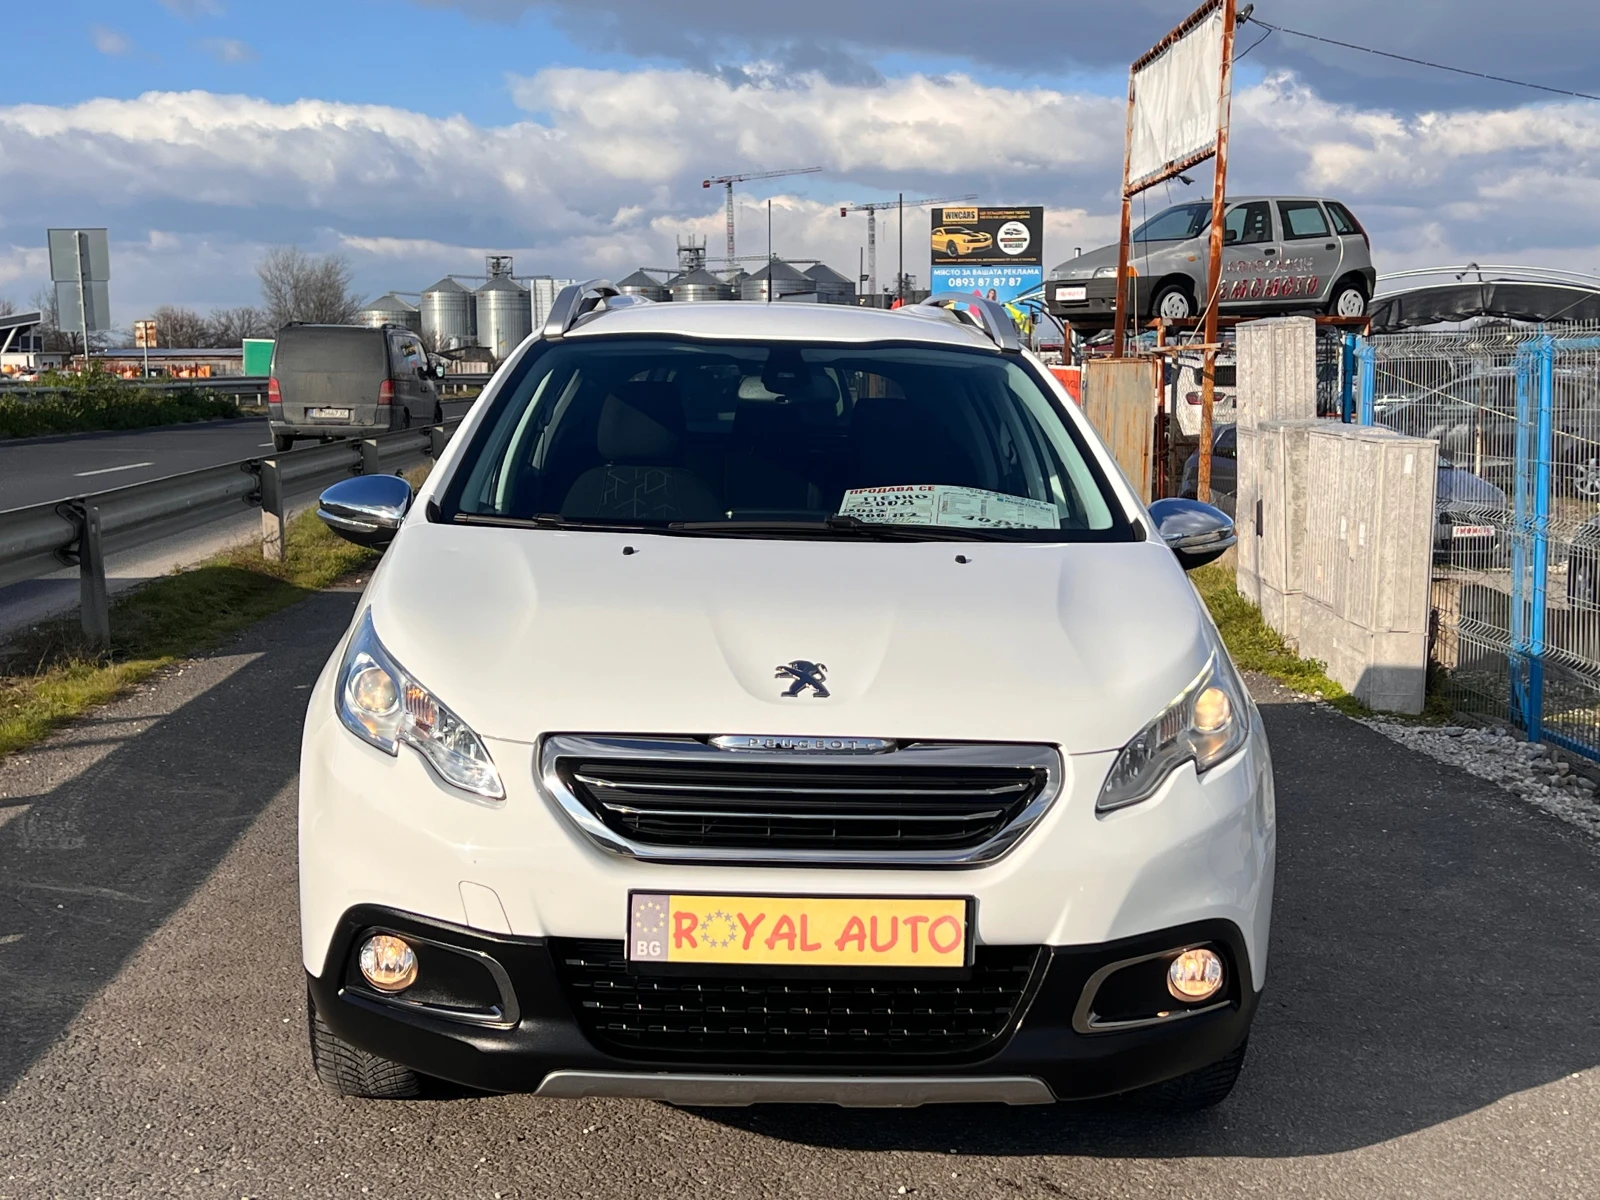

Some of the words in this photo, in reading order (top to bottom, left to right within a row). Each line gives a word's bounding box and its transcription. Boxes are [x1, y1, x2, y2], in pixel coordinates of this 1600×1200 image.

[945, 211, 976, 220] WINCARS
[933, 268, 961, 276] МЯСТО
[962, 268, 972, 276] ЗА
[973, 268, 1002, 276] ВАШАТА
[1004, 268, 1040, 276] РЕКЛАМА
[948, 277, 974, 288] 0893
[977, 277, 990, 288] 87
[993, 277, 1005, 288] 87
[1008, 277, 1022, 288] 87
[849, 486, 914, 495] ПРОДАВА
[748, 738, 858, 750] PEUGEOT
[834, 914, 963, 954] AUTO
[636, 940, 661, 957] BG
